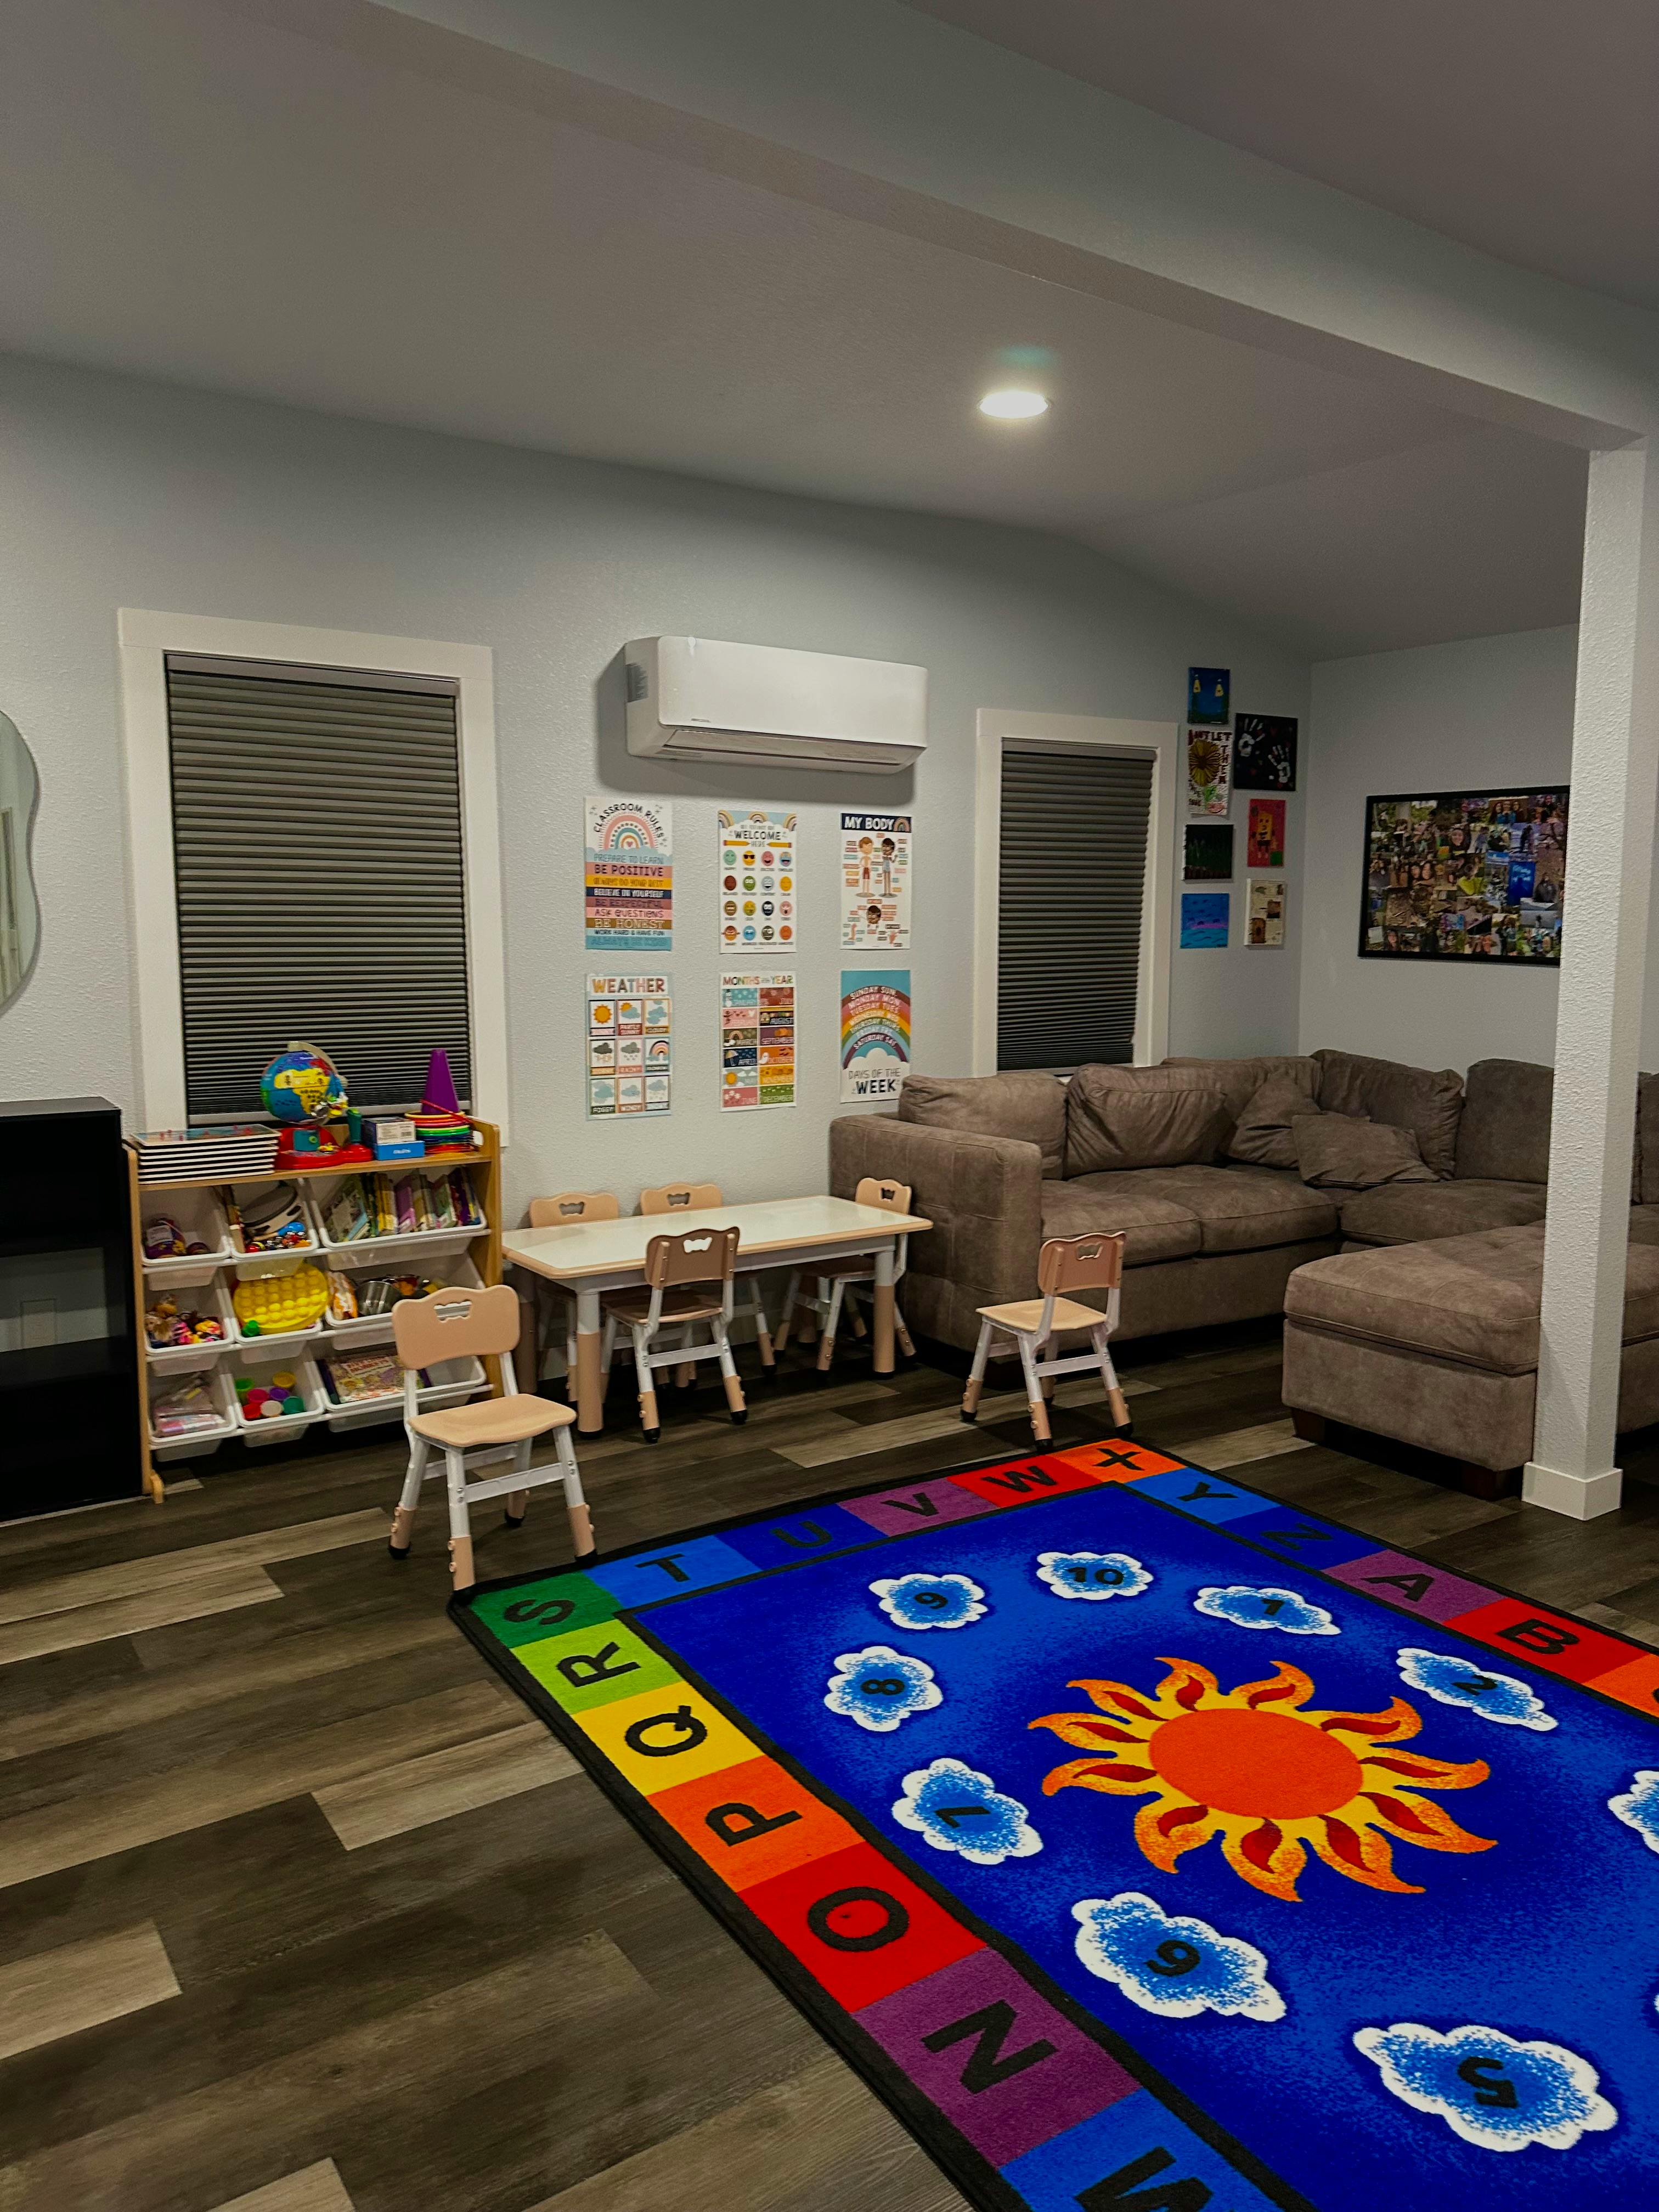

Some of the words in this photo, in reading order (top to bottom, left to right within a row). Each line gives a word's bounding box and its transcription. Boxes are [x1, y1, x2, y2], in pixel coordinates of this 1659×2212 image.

[594, 803, 643, 832] CLASSROOM
[645, 810, 665, 838] RULES
[844, 816, 862, 829] MY
[865, 817, 895, 831] BODY
[734, 830, 781, 840] WELCOME
[594, 854, 626, 862] PREPARE
[628, 855, 637, 864] TO
[639, 856, 663, 865] LEARN
[595, 864, 607, 874] BE
[611, 865, 663, 876] POSITIVE
[595, 898, 606, 906] BE
[621, 889, 631, 897] IN
[632, 889, 664, 898] YOURSELF
[595, 908, 612, 917] ASK
[614, 909, 664, 918] QUESTIONS
[594, 918, 611, 928] BE
[615, 919, 665, 929] HONEST
[592, 977, 665, 993] WEATHER
[723, 976, 760, 985] MONTHS
[772, 975, 793, 984] YEAR
[848, 994, 881, 1009] MONDAY
[850, 986, 879, 1000] SUNDAY
[850, 1002, 880, 1016] TUESDAY
[853, 1034, 884, 1049] SATURDAY
[849, 1070, 870, 1080] DAYS
[872, 1069, 882, 1078] OF
[884, 1068, 901, 1077] THE
[855, 1079, 897, 1094] WEEK
[1092, 1448, 1144, 1471] X
[982, 1465, 1057, 1493] W
[1177, 1481, 1239, 1502] Y
[881, 1492, 939, 1517] V
[771, 1520, 833, 1548] U
[1260, 1523, 1334, 1550] Z
[634, 1553, 691, 1583] T
[1068, 1567, 1125, 1585] 10
[1361, 1573, 1435, 1602] A
[914, 1592, 948, 1609] 9
[1262, 1599, 1285, 1616] 1
[504, 1599, 575, 1626] S
[1494, 1618, 1581, 1655] B
[556, 1641, 641, 1688] R
[860, 1678, 905, 1695] 8
[1453, 1674, 1498, 1696] 2
[625, 1705, 708, 1757] Q
[705, 1803, 803, 1847] P
[935, 1806, 991, 1829] 7
[808, 1886, 909, 1952] O
[921, 1999, 1059, 2095] N
[1457, 2056, 1518, 2108] 5
